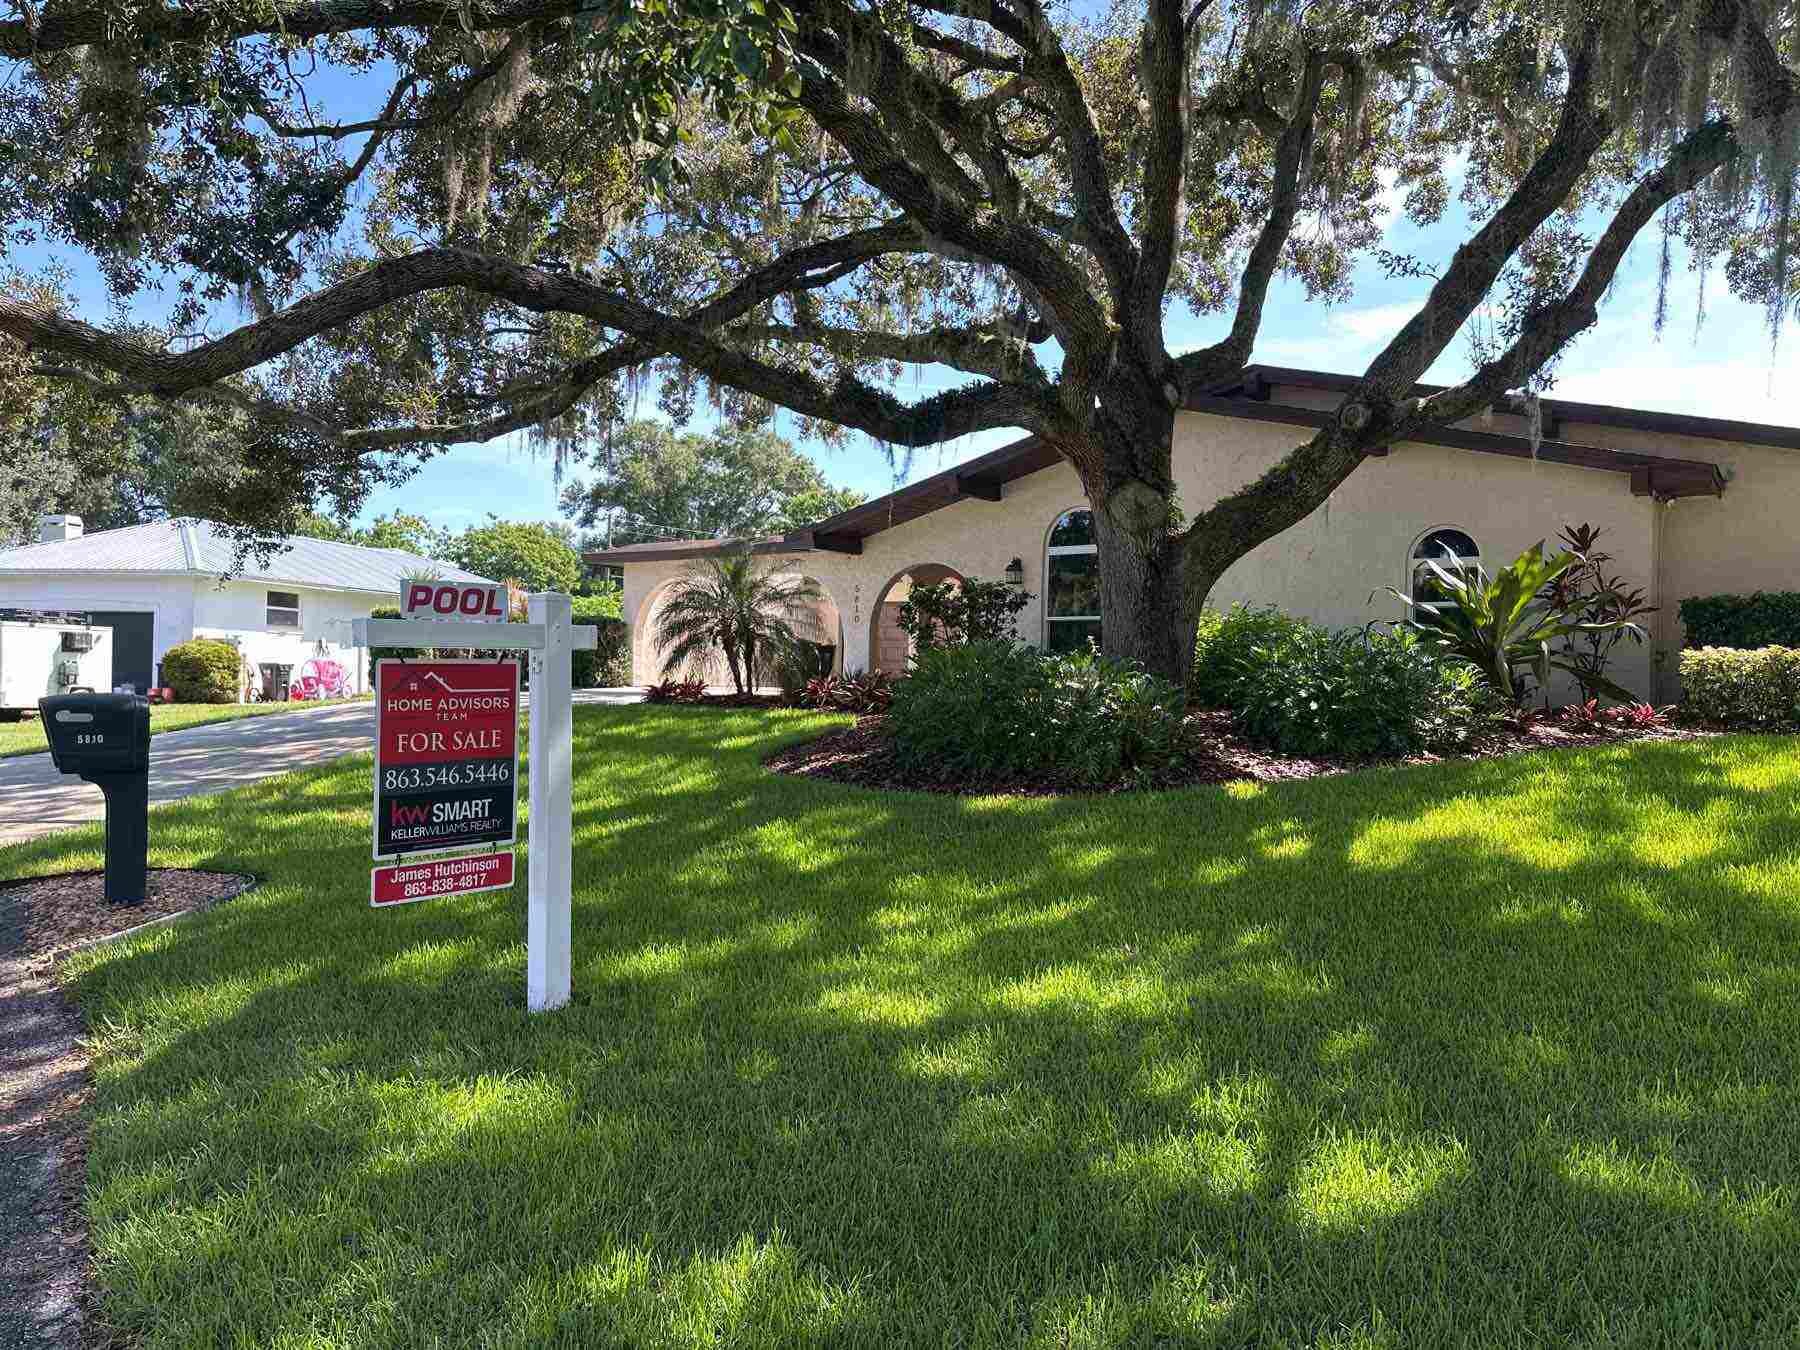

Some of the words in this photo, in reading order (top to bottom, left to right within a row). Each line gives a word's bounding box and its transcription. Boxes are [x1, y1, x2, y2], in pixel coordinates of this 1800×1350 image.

[408, 584, 503, 615] POOL
[387, 698, 433, 712] HOME
[437, 697, 510, 711] ADVISORS
[436, 712, 468, 721] TEAM
[77, 734, 104, 745] 5810
[396, 732, 448, 753] FOR
[452, 729, 502, 751] SALE
[385, 763, 509, 790] 863.546.5446
[391, 799, 430, 826] kw
[432, 798, 493, 823] SMART
[470, 818, 503, 832] REALTY
[391, 867, 432, 884] James
[435, 858, 500, 878] Hutchinson
[404, 873, 488, 897] 863-838-4817
